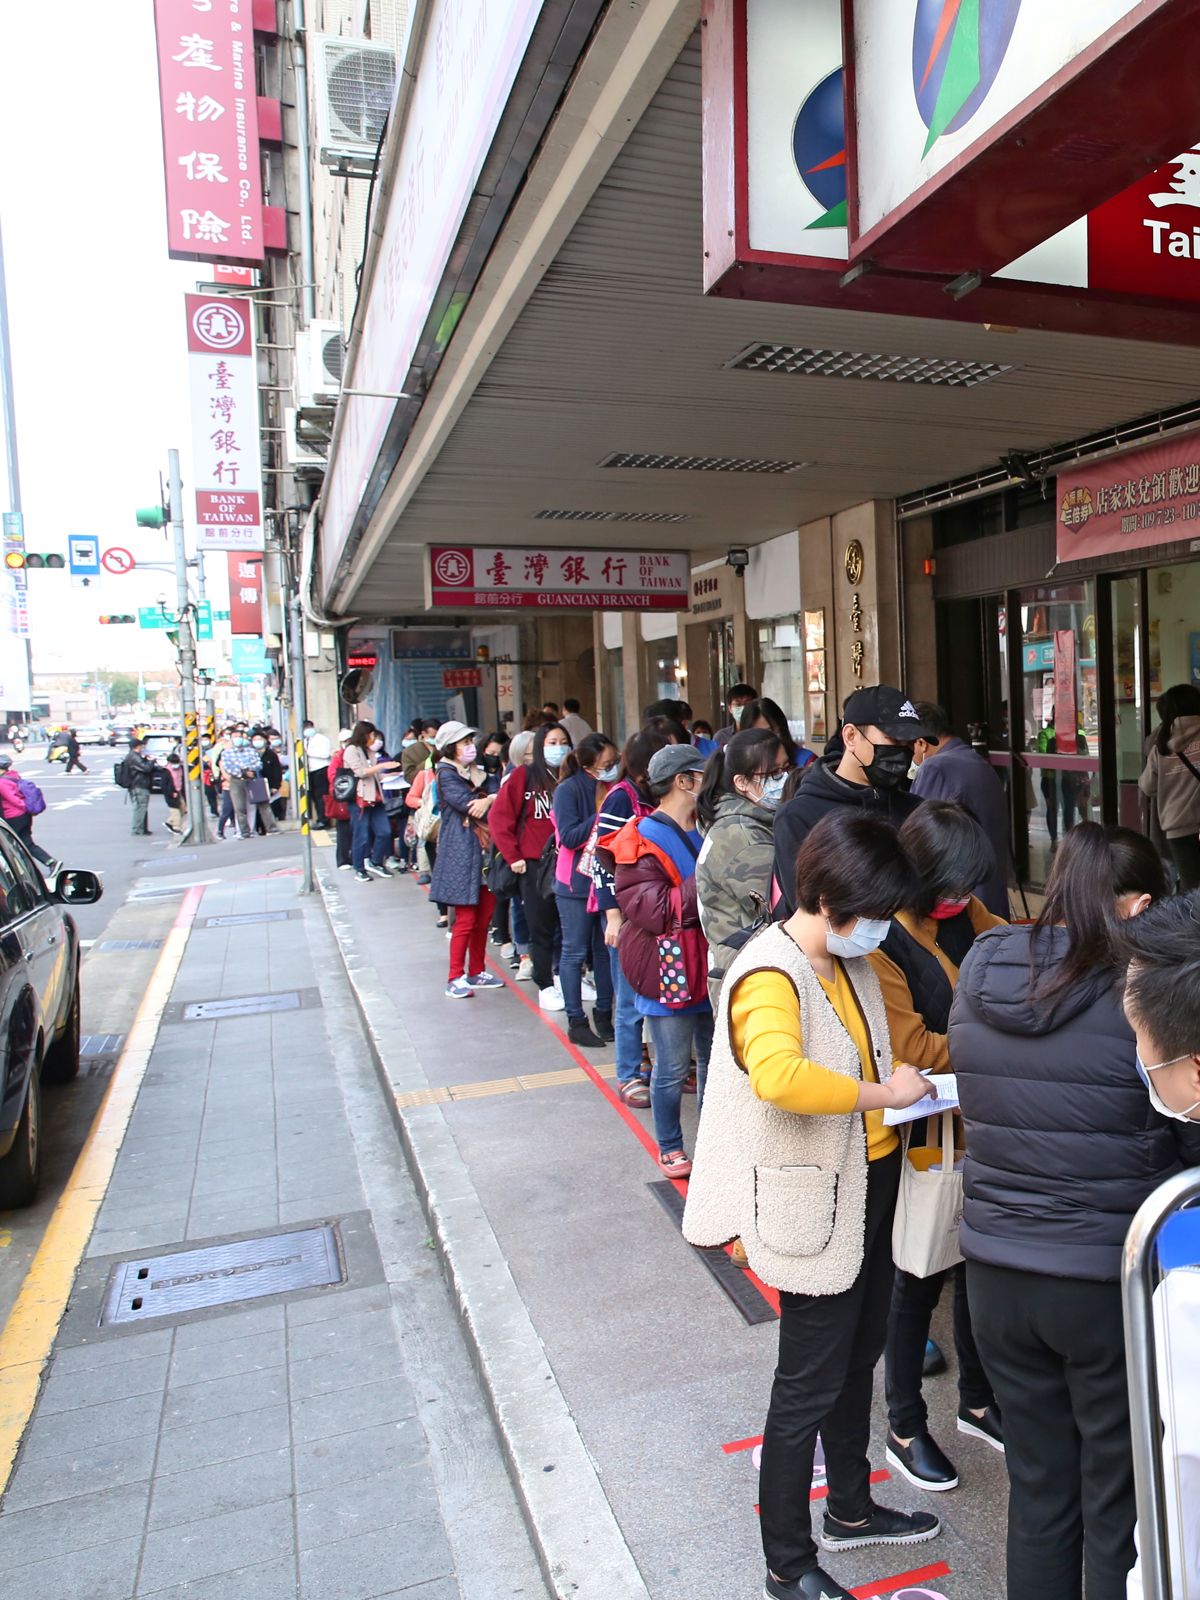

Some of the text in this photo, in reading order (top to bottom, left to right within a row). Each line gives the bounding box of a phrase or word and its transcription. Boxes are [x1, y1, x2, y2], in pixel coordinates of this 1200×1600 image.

[230, 21, 242, 32] &
[232, 40, 244, 90] Marine
[171, 0, 231, 243] 產物保險
[235, 98, 247, 171] Insurance
[240, 215, 253, 245] Ltd.
[208, 360, 242, 486] 臺灣銀行
[210, 494, 246, 505] BANK
[218, 504, 237, 514] OF
[202, 512, 254, 523] TAIWAN
[639, 555, 670, 567] BANK
[486, 552, 628, 587] 臺灣銀行
[639, 567, 653, 577] OF
[639, 576, 682, 588] TAIWAN
[474, 592, 524, 606] 館前分行
[537, 594, 651, 607] GUANCIAN BRANCH
